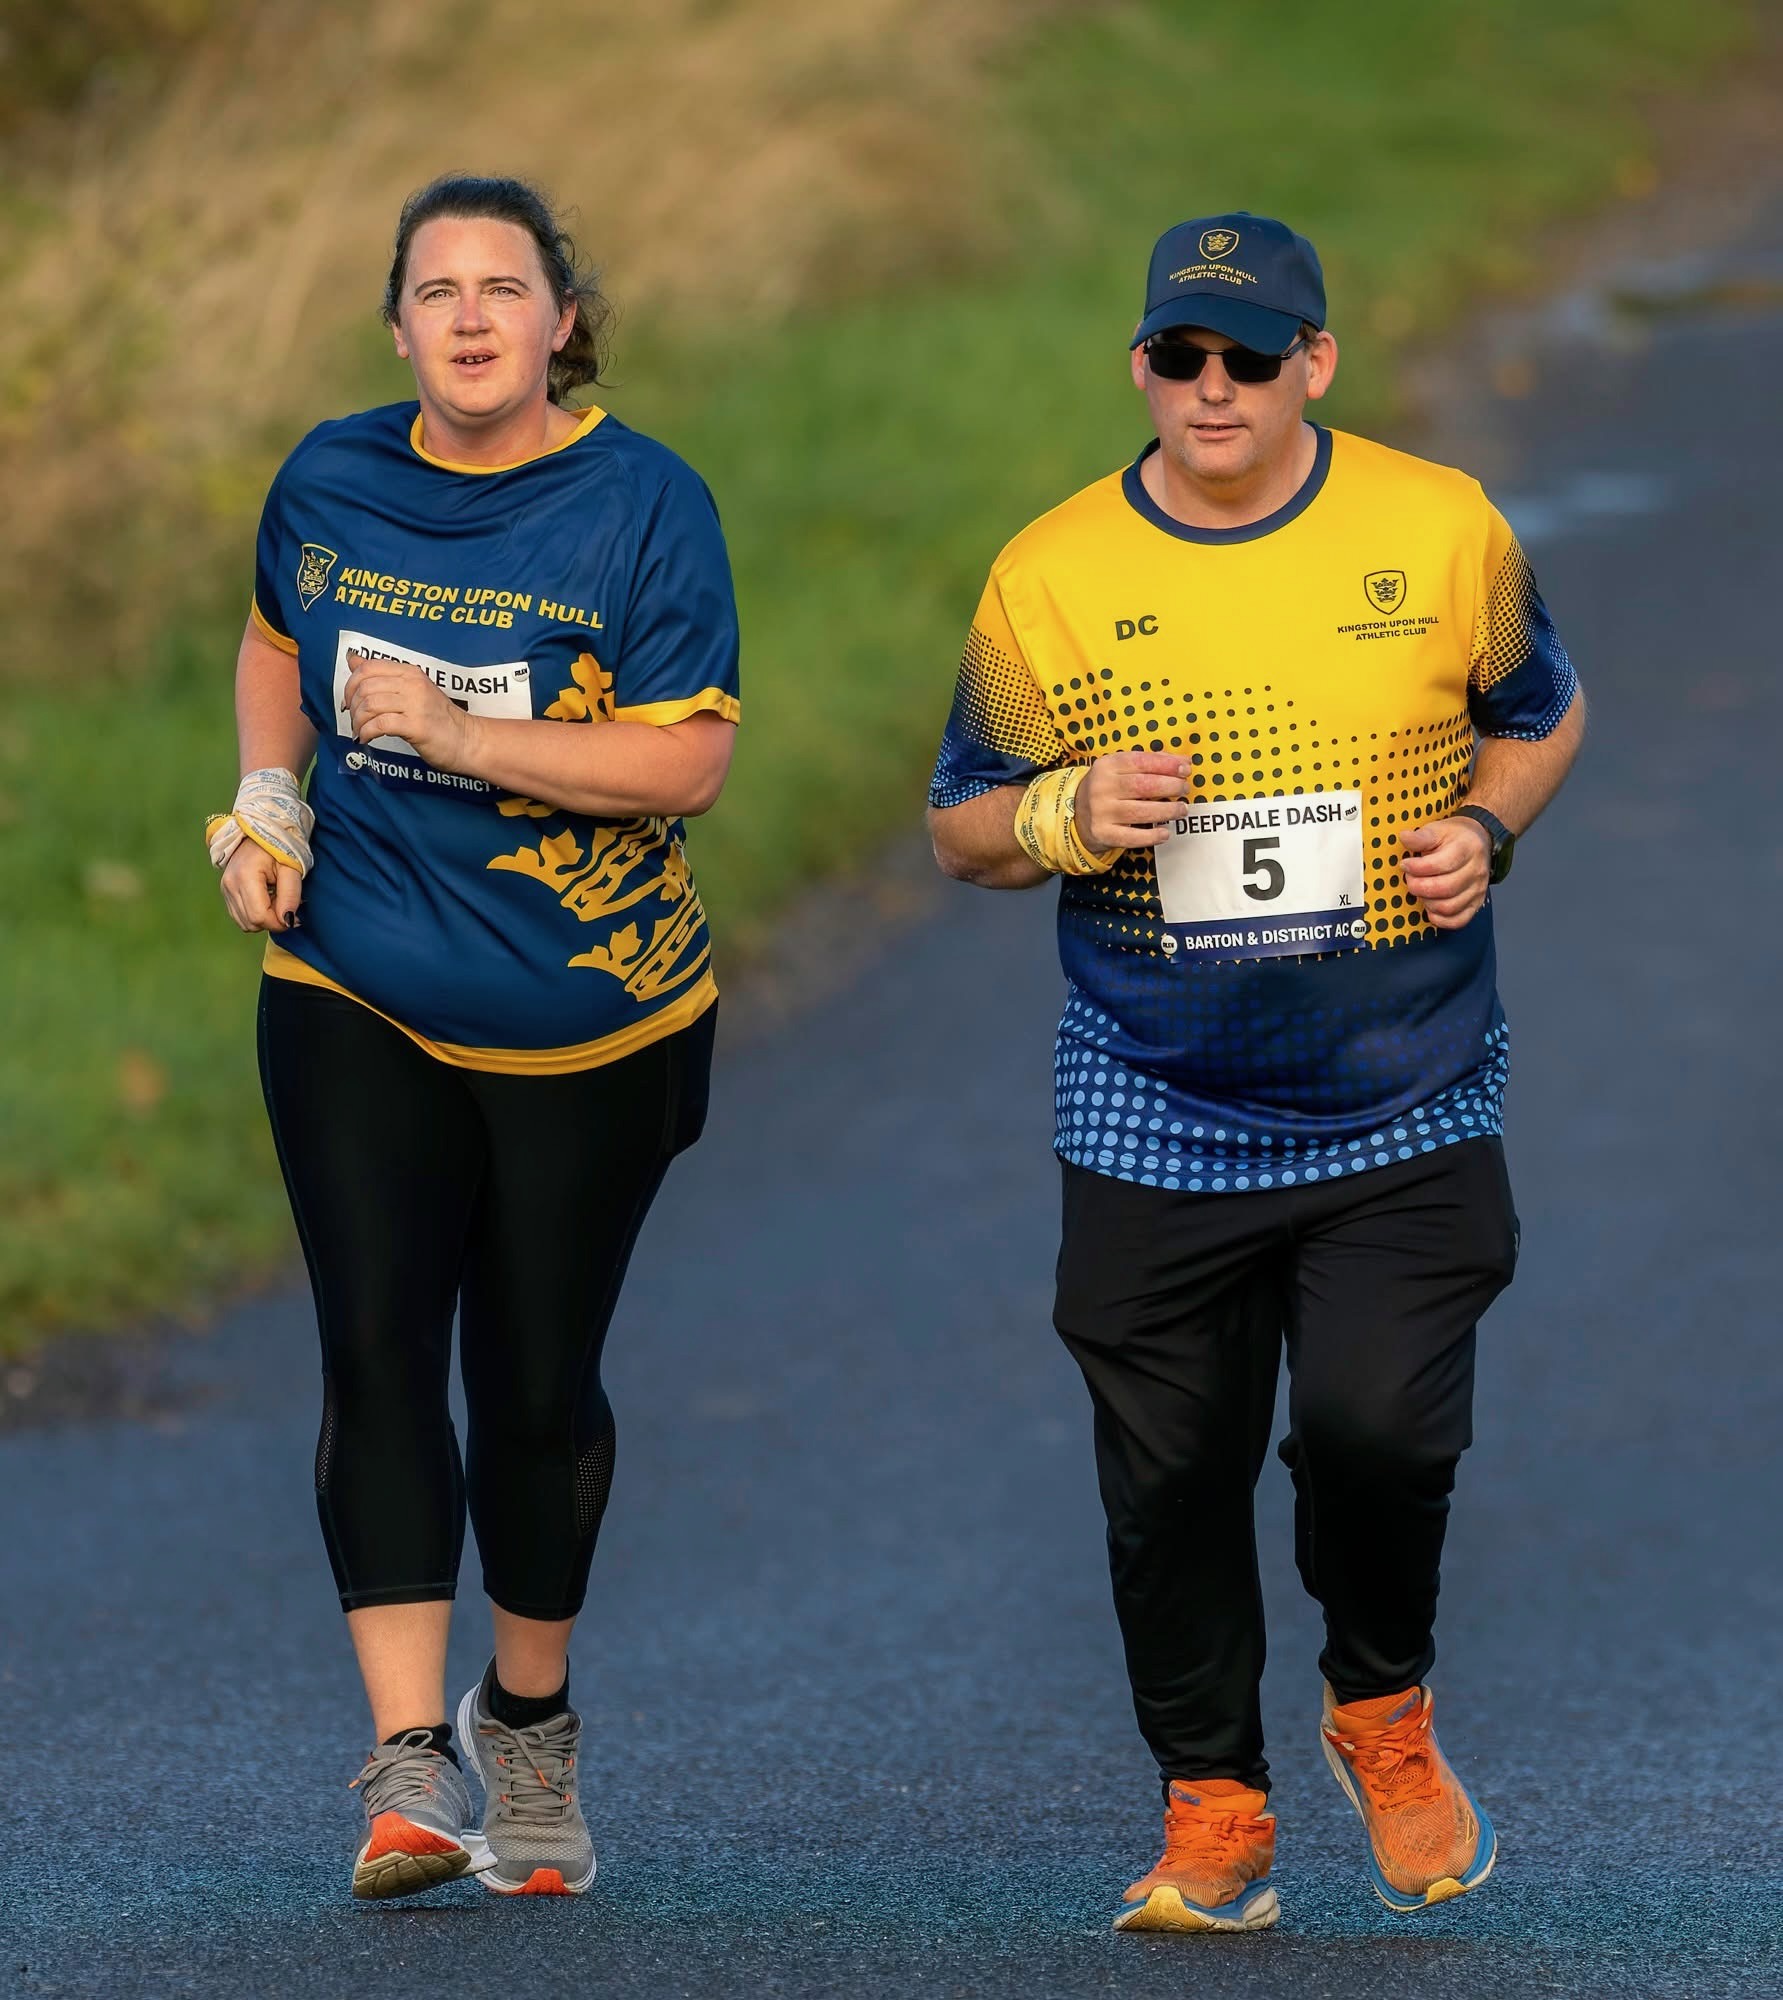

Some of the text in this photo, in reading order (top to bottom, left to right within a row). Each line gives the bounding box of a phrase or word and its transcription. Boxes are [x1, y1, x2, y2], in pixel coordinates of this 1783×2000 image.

[1169, 264, 1258, 284] KINGSTON UPON HULL
[1178, 271, 1242, 285] ATHLETIC CLUB
[334, 585, 514, 629] ATHLETIC CLUB
[338, 567, 604, 629] KINGSTON UPON HULL
[1115, 615, 1159, 641] DC
[1337, 616, 1440, 634] KINGSTON UPON HULL
[1356, 627, 1426, 641] ATHLETIC CLUB
[452, 674, 508, 694] DASH
[359, 751, 409, 779] BARTON
[413, 768, 424, 782] &
[1176, 803, 1341, 836] DEEPDALE DASH
[1242, 836, 1285, 901] 5
[1339, 894, 1352, 907] XL
[1185, 922, 1350, 950] BARTON & DISTRICT AC
